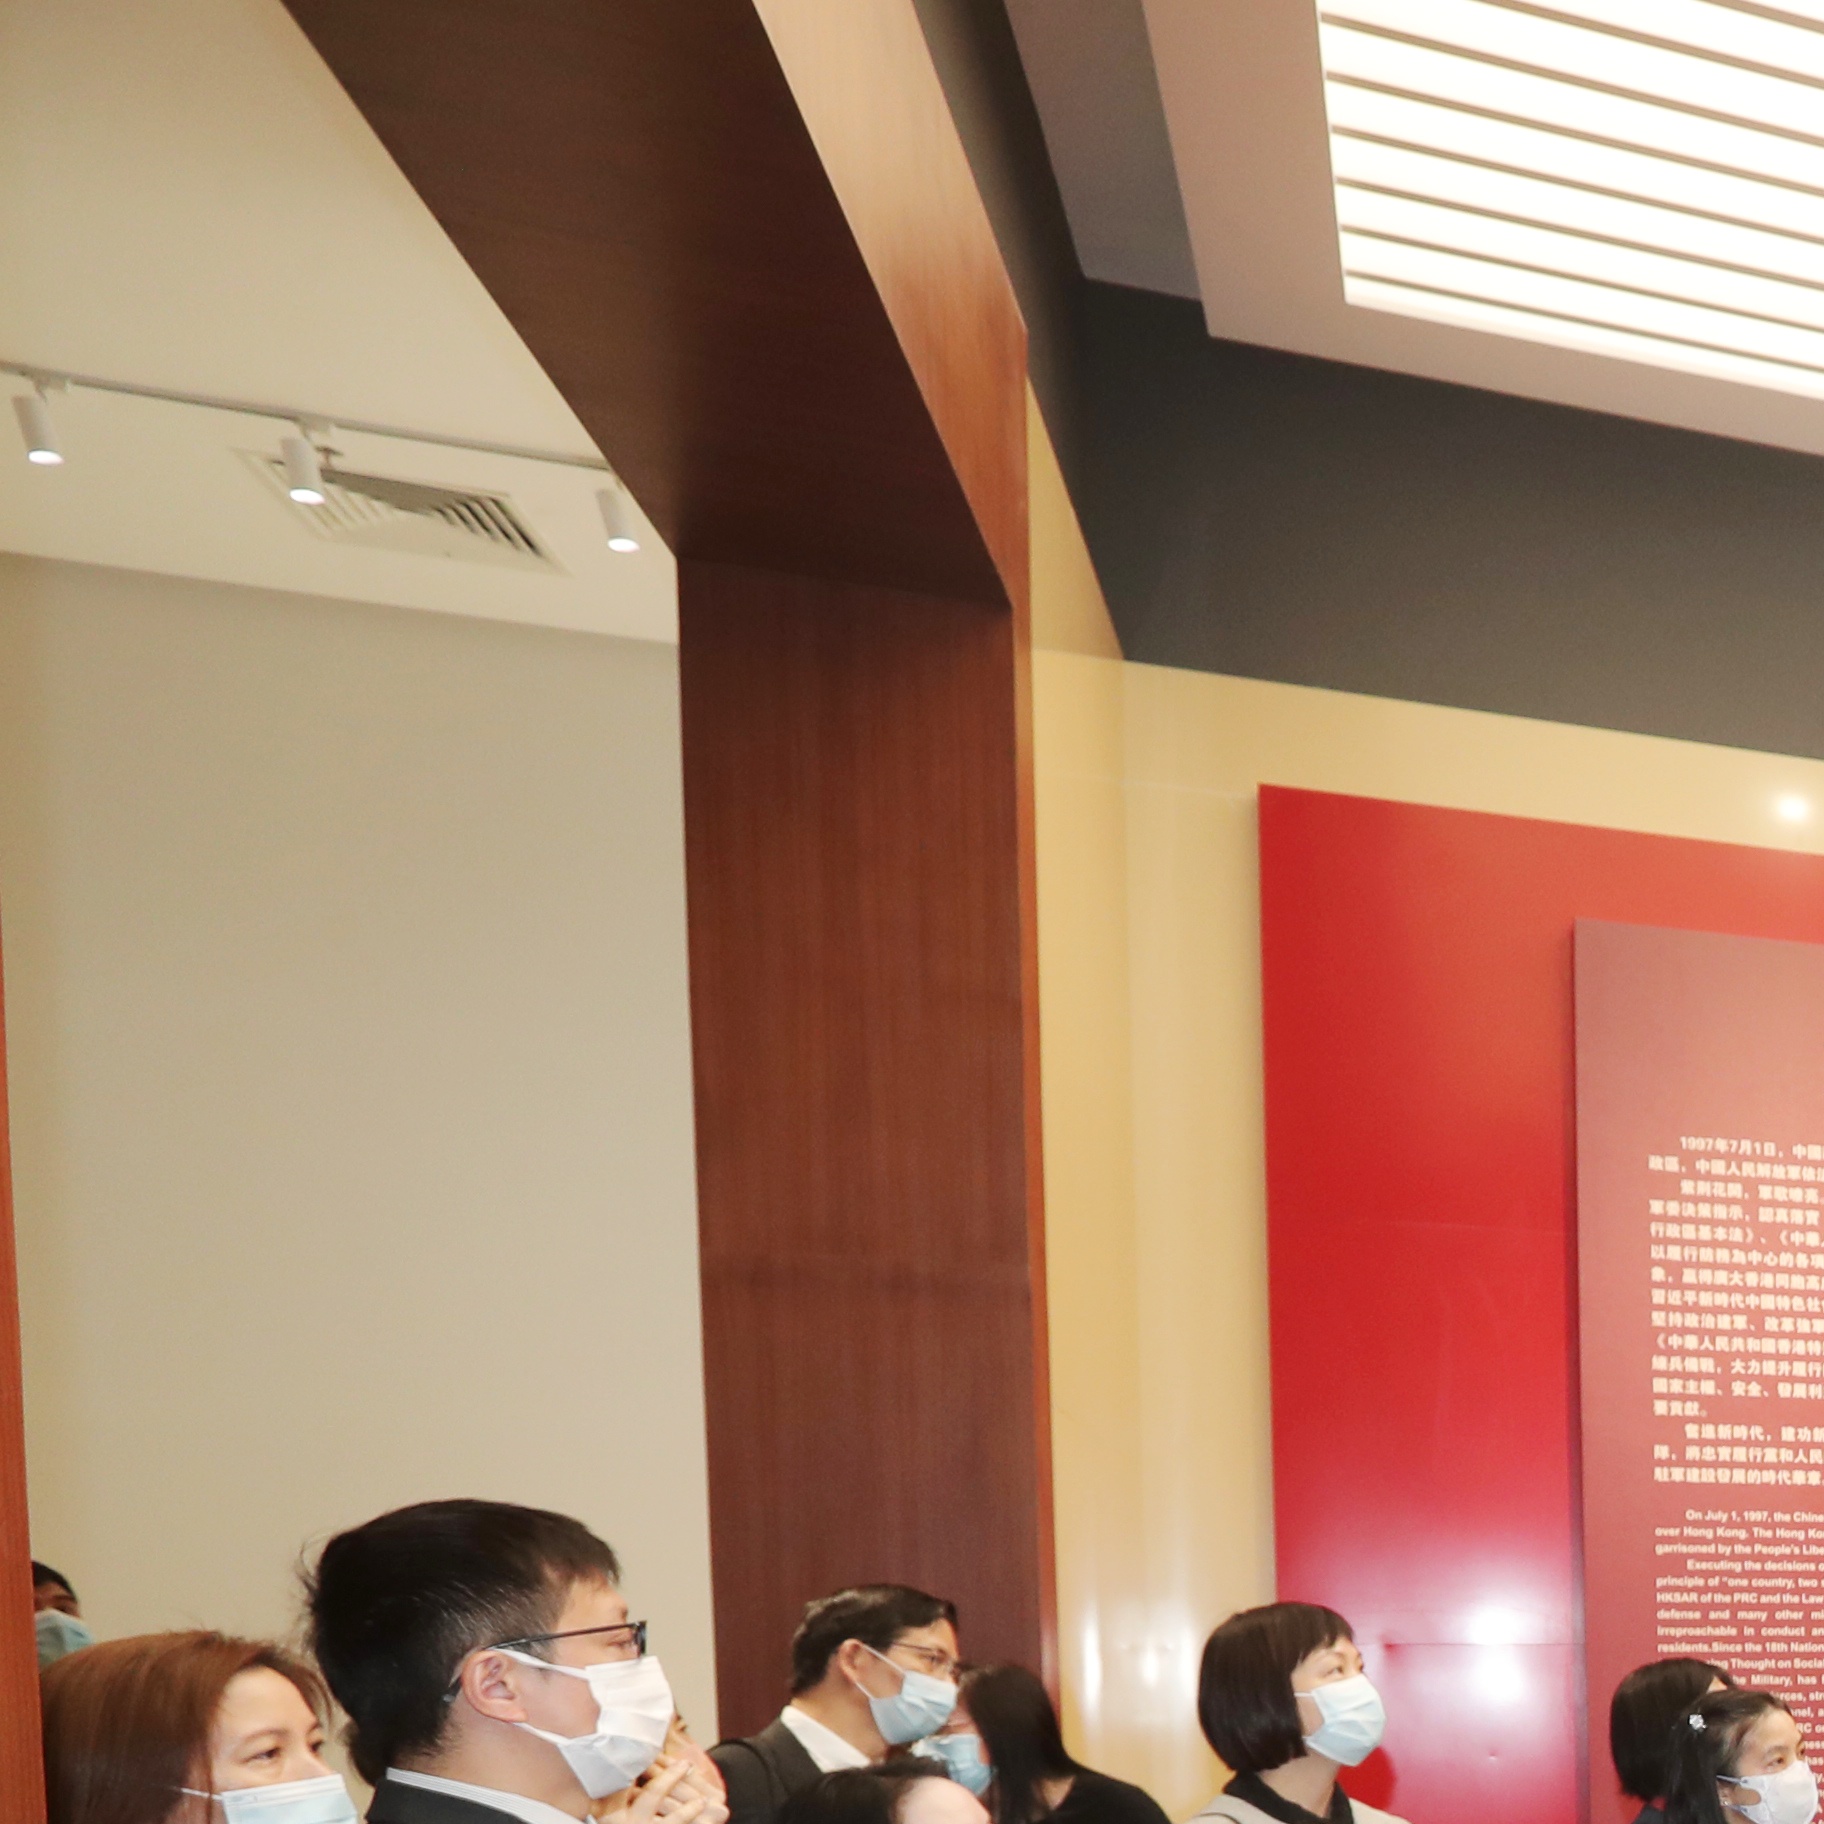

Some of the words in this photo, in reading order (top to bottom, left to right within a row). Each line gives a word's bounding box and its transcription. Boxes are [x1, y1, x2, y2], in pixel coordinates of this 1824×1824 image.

[1685, 1509, 1702, 1520] On
[1704, 1510, 1728, 1522] July
[1773, 1511, 1791, 1522] the
[1654, 1527, 1680, 1536] over
[1683, 1526, 1713, 1539] Hong
[1716, 1526, 1748, 1539] Kong.
[1752, 1526, 1773, 1538] The
[1775, 1527, 1805, 1540] Hong
[1655, 1543, 1715, 1554] garrisoned
[1717, 1543, 1732, 1555] by
[1733, 1543, 1752, 1553] the
[1686, 1559, 1742, 1572] Executing
[1743, 1560, 1762, 1570] the
[1763, 1560, 1816, 1571] decisions
[1656, 1575, 1705, 1587] principle
[1707, 1575, 1720, 1586] of
[1751, 1577, 1795, 1589] country,
[1797, 1577, 1818, 1587] two
[1700, 1592, 1712, 1602] of
[1713, 1592, 1731, 1603] the
[1733, 1592, 1757, 1603] PRC
[1759, 1593, 1780, 1603] and
[1782, 1592, 1800, 1603] the
[1801, 1593, 1824, 1603] Law
[1656, 1608, 1701, 1619] defense
[1708, 1609, 1730, 1619] and
[1737, 1610, 1767, 1621] many
[1774, 1609, 1803, 1619] other
[1657, 1625, 1737, 1636] irreproachable
[1743, 1625, 1754, 1635] in
[1760, 1626, 1805, 1636] conduct
[1744, 1642, 1762, 1652] the
[1765, 1641, 1788, 1652] 18th
